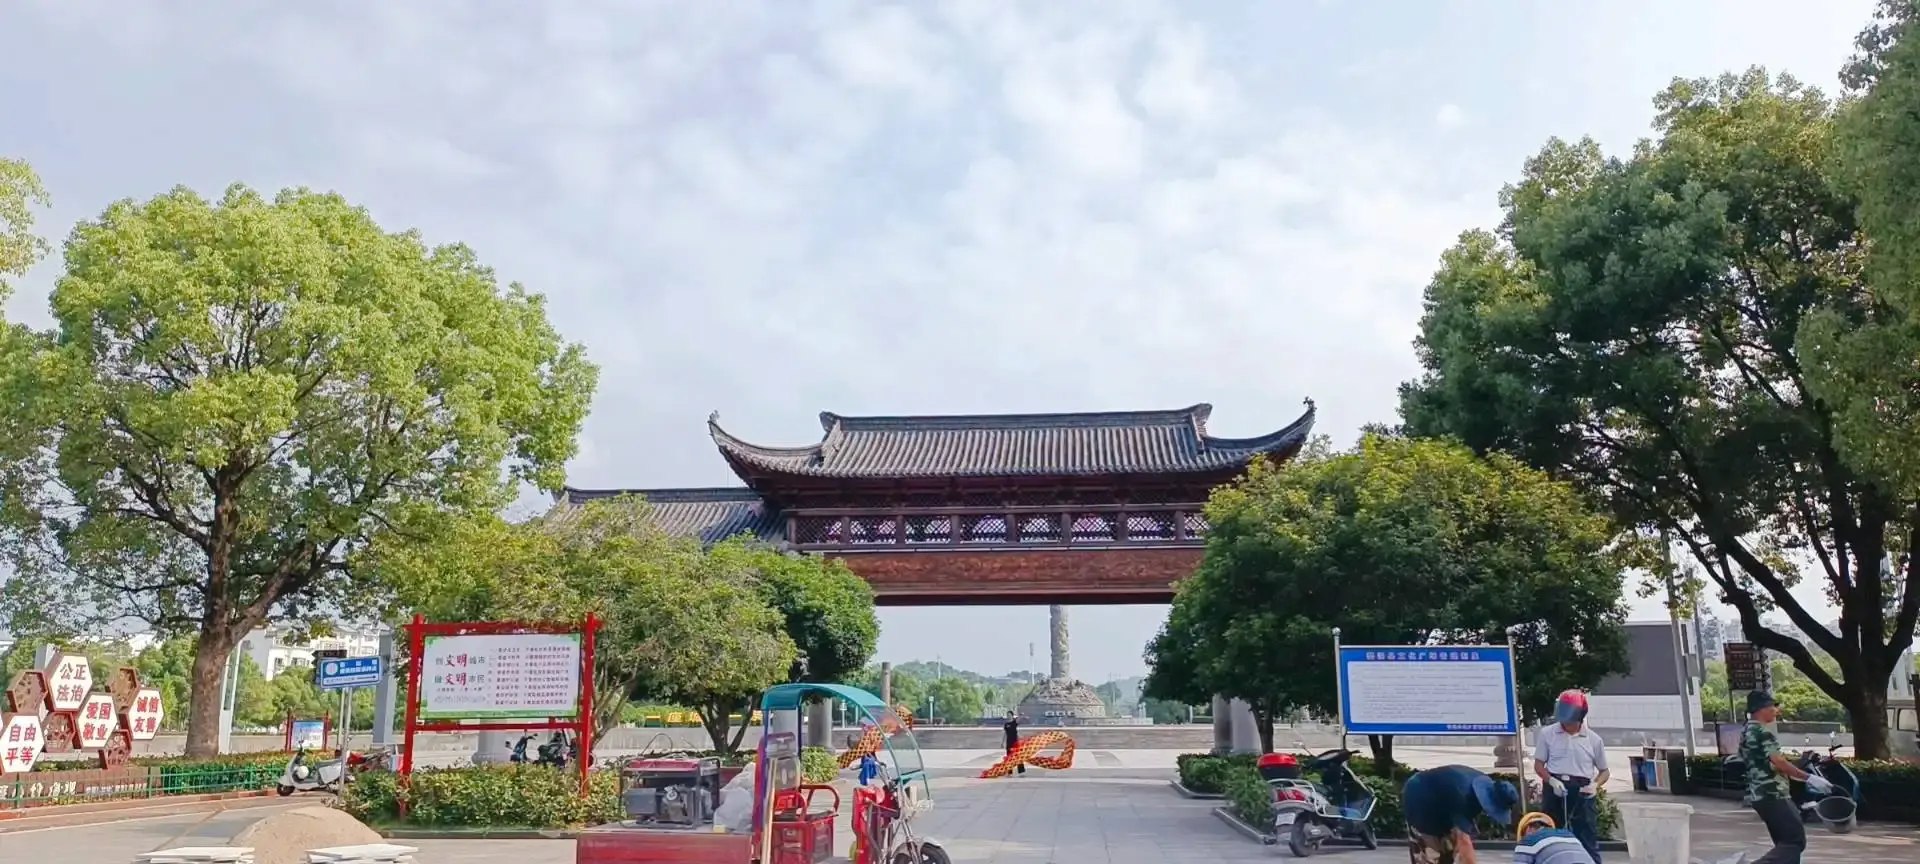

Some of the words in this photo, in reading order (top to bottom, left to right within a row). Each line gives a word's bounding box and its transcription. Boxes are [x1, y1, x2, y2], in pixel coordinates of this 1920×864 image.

[59, 662, 87, 680] 公正
[56, 684, 84, 702] 法治
[86, 701, 112, 720] 爱国
[136, 696, 160, 713] 诚信
[9, 724, 37, 742] 自由
[82, 723, 108, 741] 敬业
[133, 716, 157, 733] 友善
[5, 746, 34, 766] 平等
